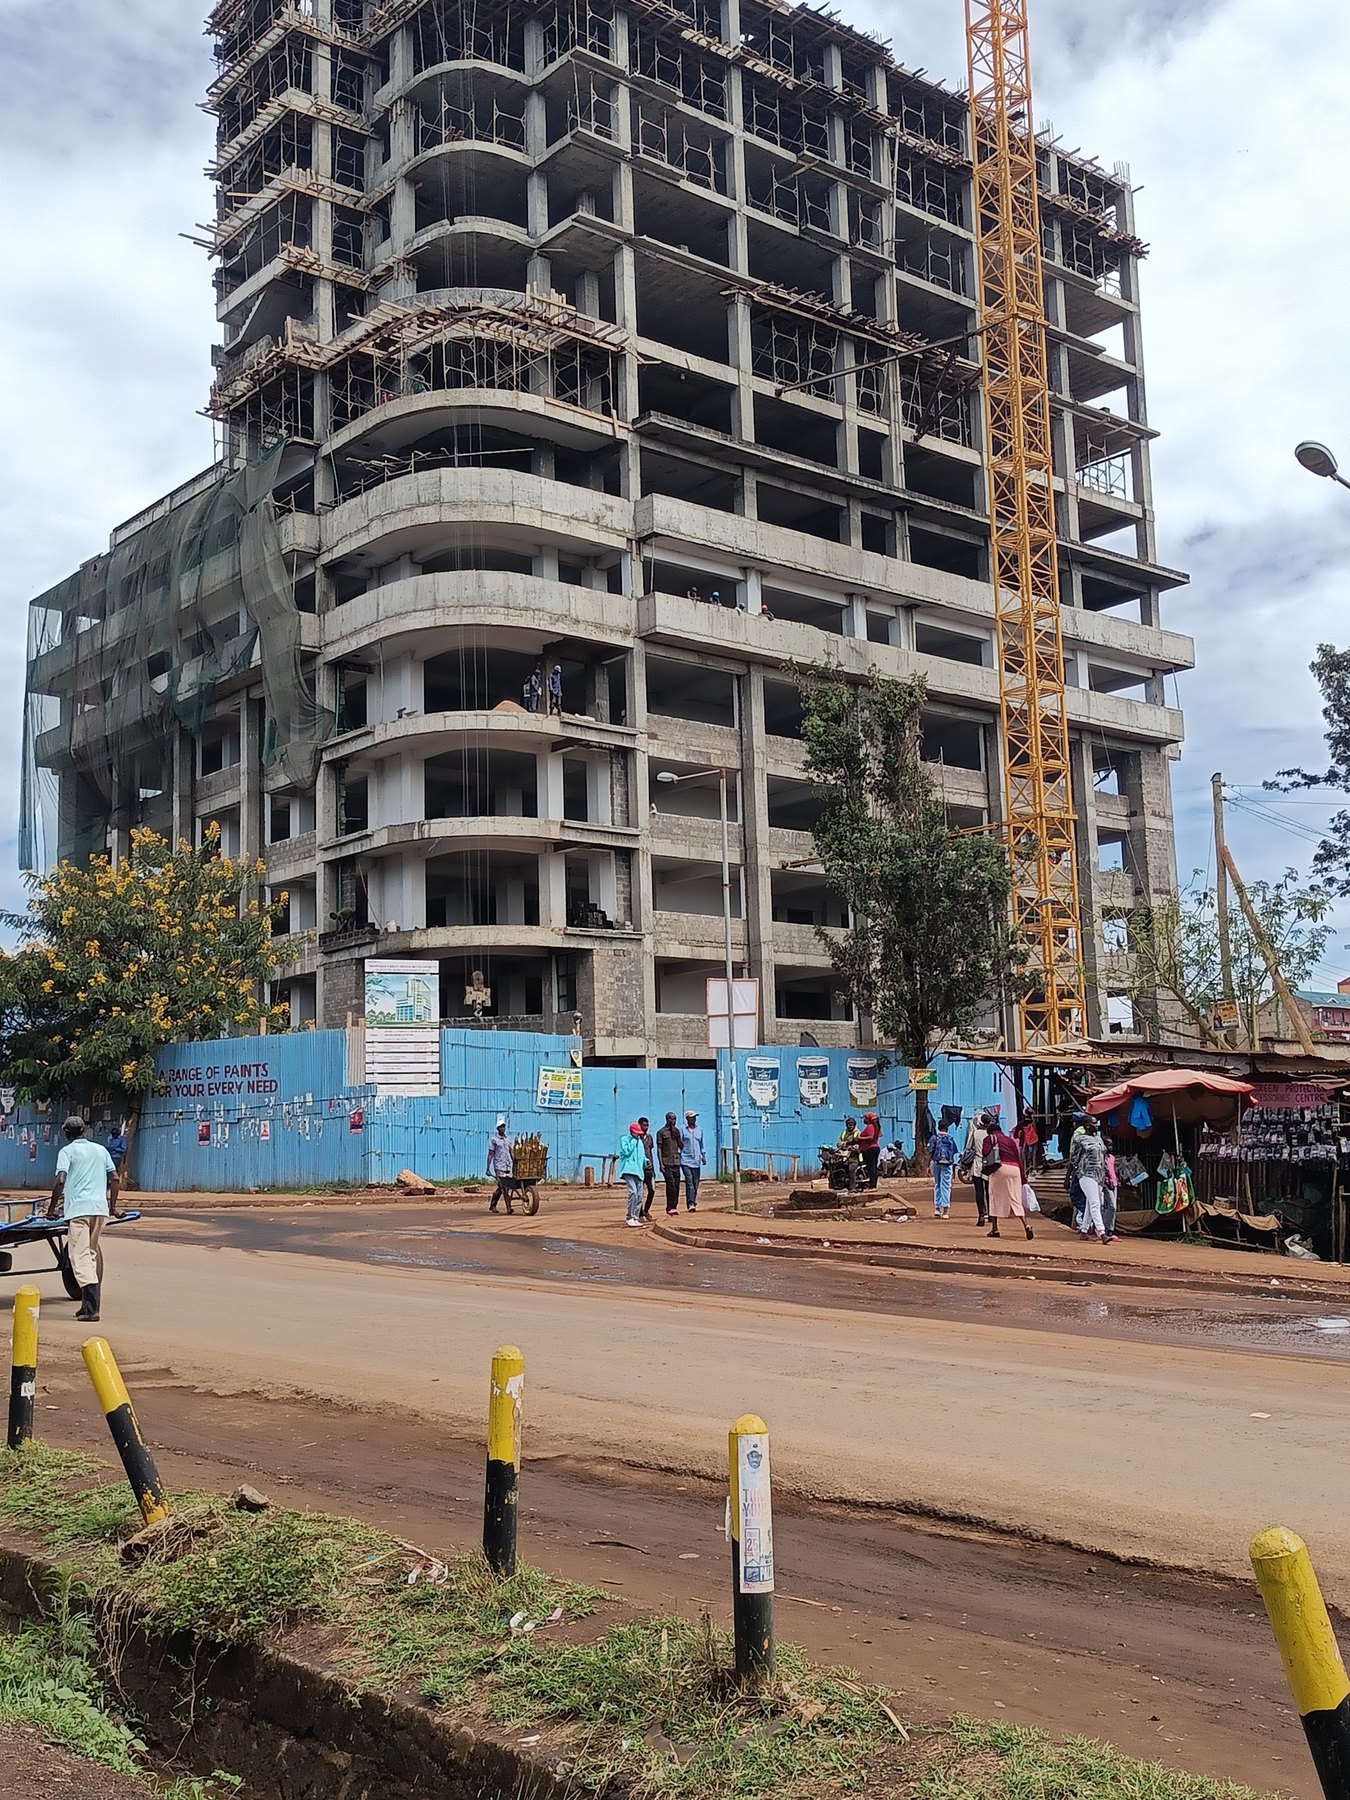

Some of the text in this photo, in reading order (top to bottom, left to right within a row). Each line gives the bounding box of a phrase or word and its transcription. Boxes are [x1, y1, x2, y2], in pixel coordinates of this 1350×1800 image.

[168, 1067, 202, 1082] RANGE
[205, 1066, 220, 1080] OF
[224, 1062, 269, 1078] PAINTS
[151, 1079, 278, 1099] FOR YOUR EVERY NEED
